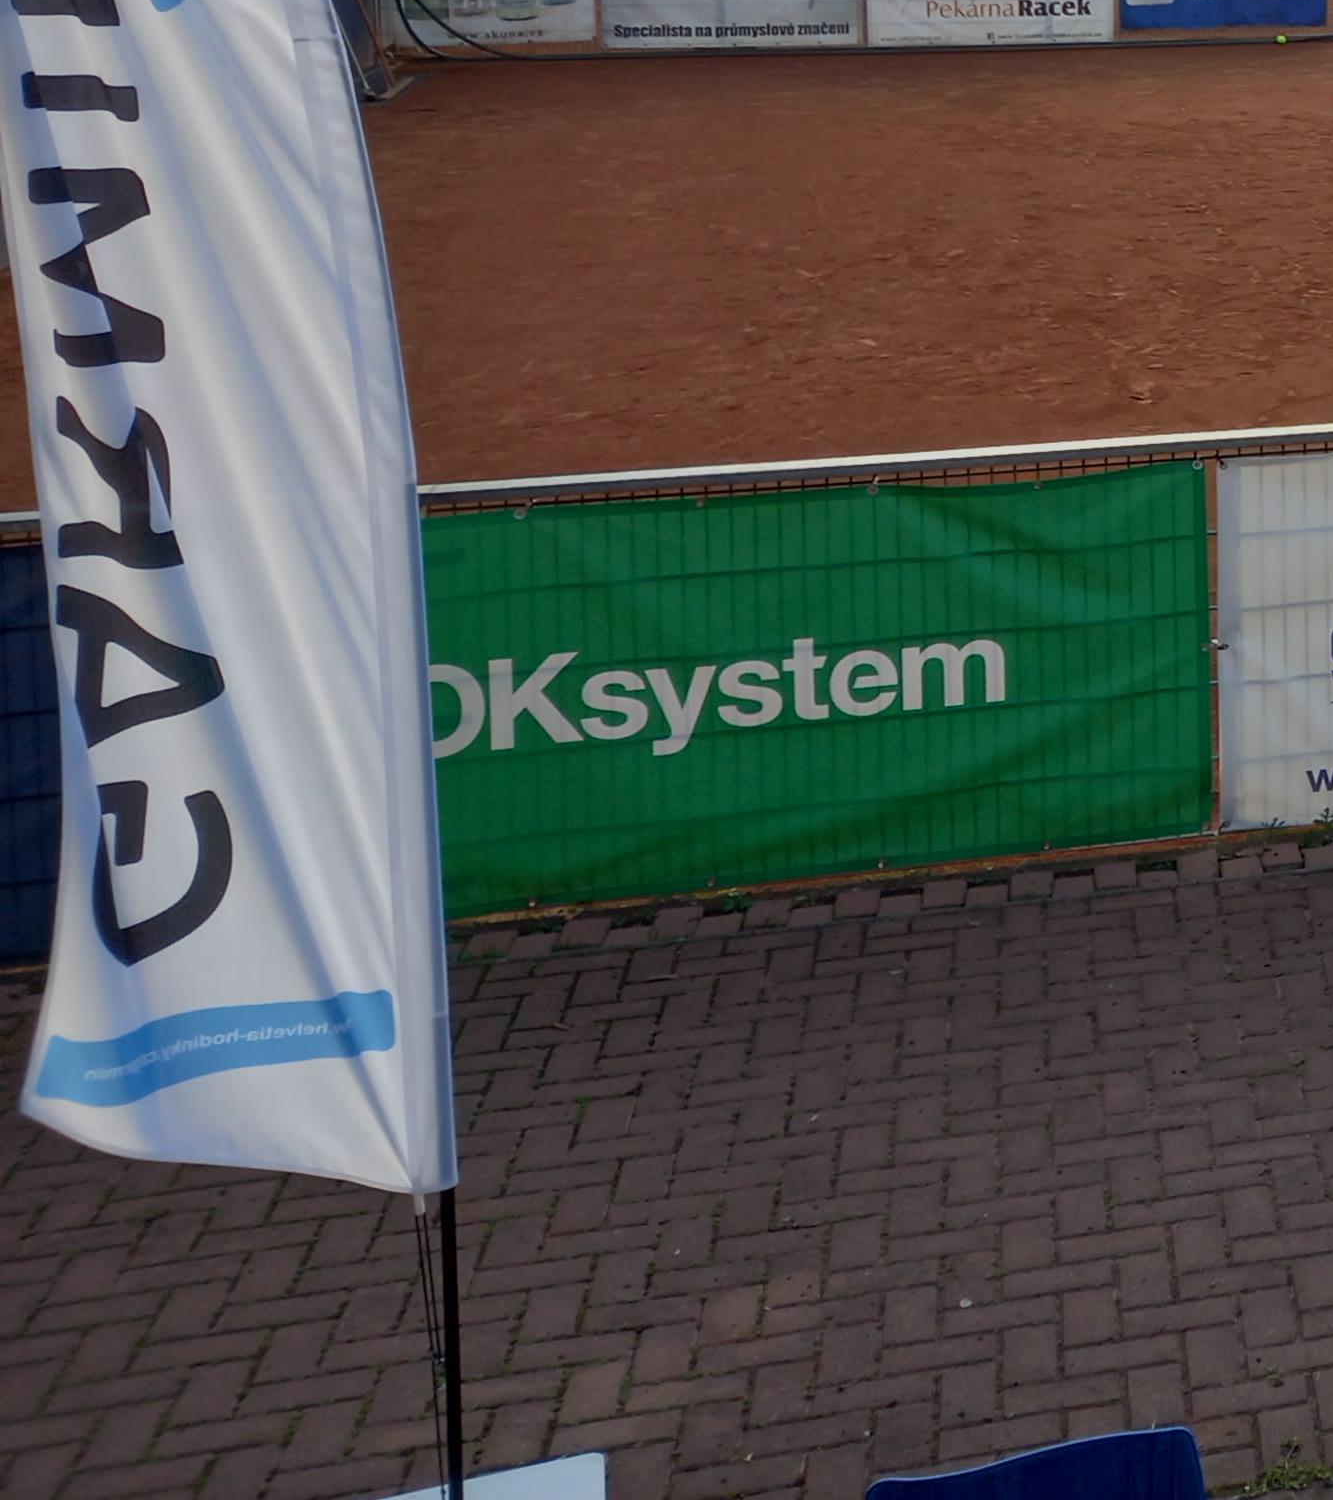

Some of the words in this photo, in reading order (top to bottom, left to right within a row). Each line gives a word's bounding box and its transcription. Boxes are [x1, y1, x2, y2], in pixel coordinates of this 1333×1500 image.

[448, 30, 545, 40] w.akuna.cz
[614, 24, 692, 38] Specialista
[695, 26, 712, 37] na
[429, 638, 1006, 758] OKsystem
